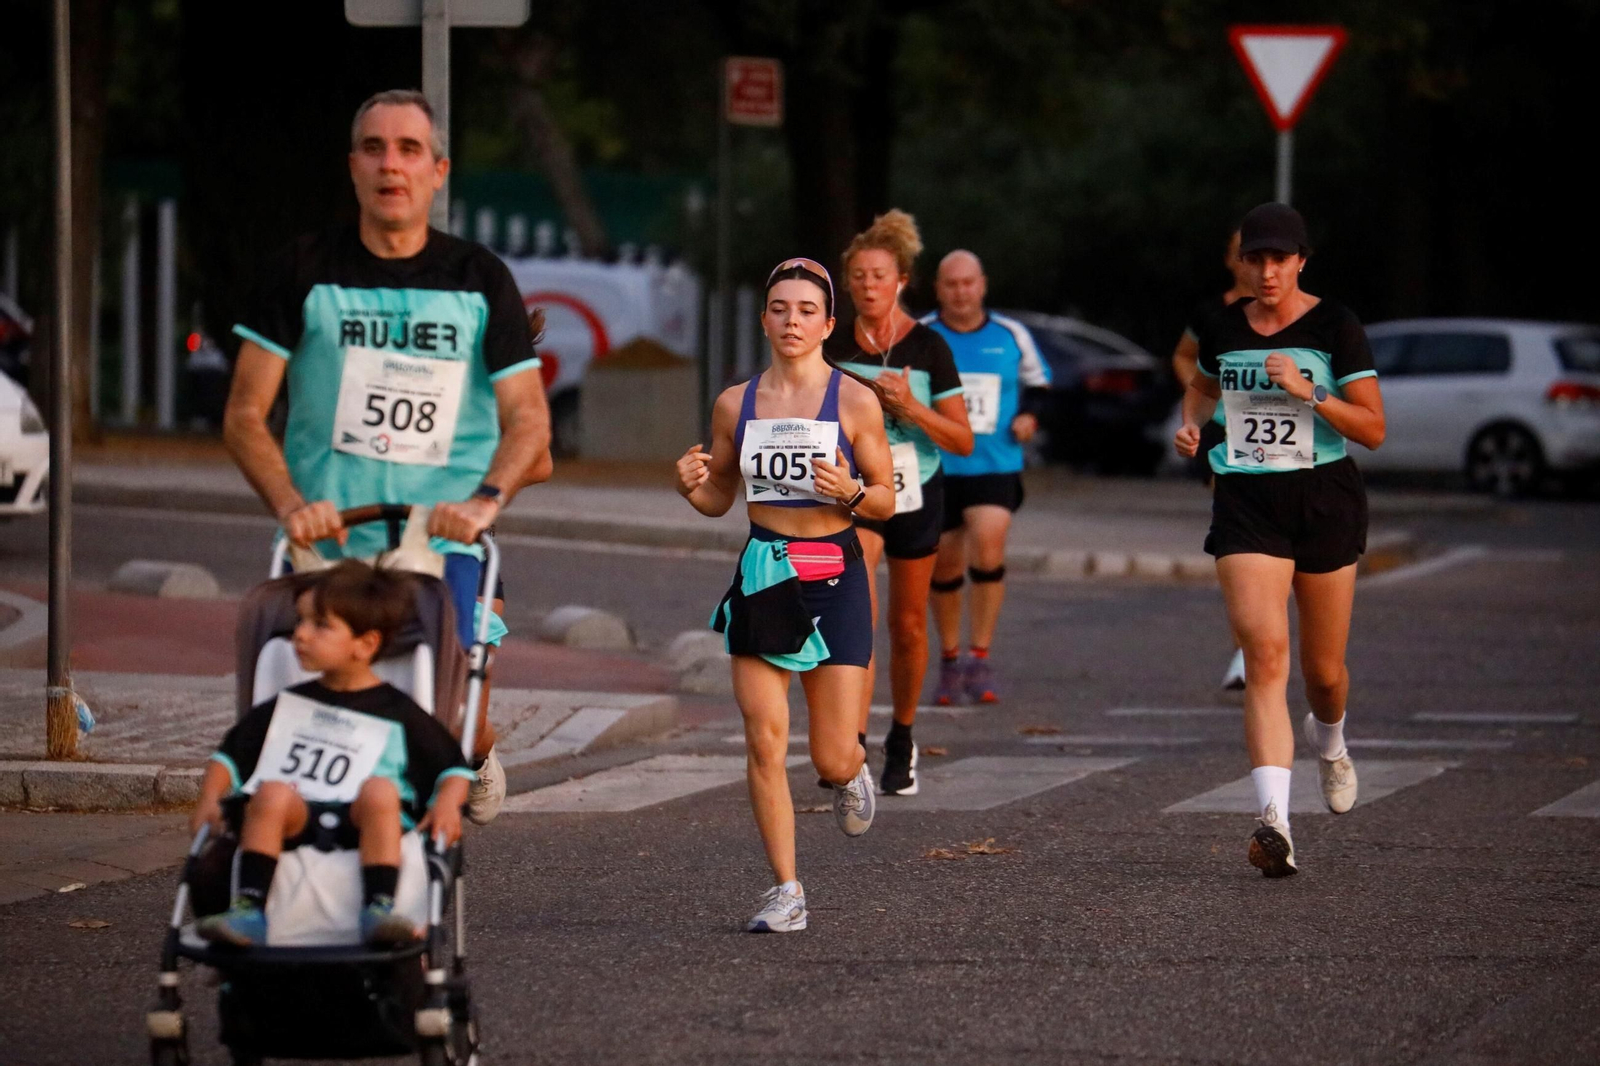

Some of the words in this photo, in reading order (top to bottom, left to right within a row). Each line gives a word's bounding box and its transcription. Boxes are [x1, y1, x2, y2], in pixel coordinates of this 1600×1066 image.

[338, 319, 457, 351] MUJER
[1222, 368, 1313, 391] MUJR
[362, 393, 437, 433] 508
[1244, 417, 1296, 446] 232
[280, 743, 351, 786] 510
